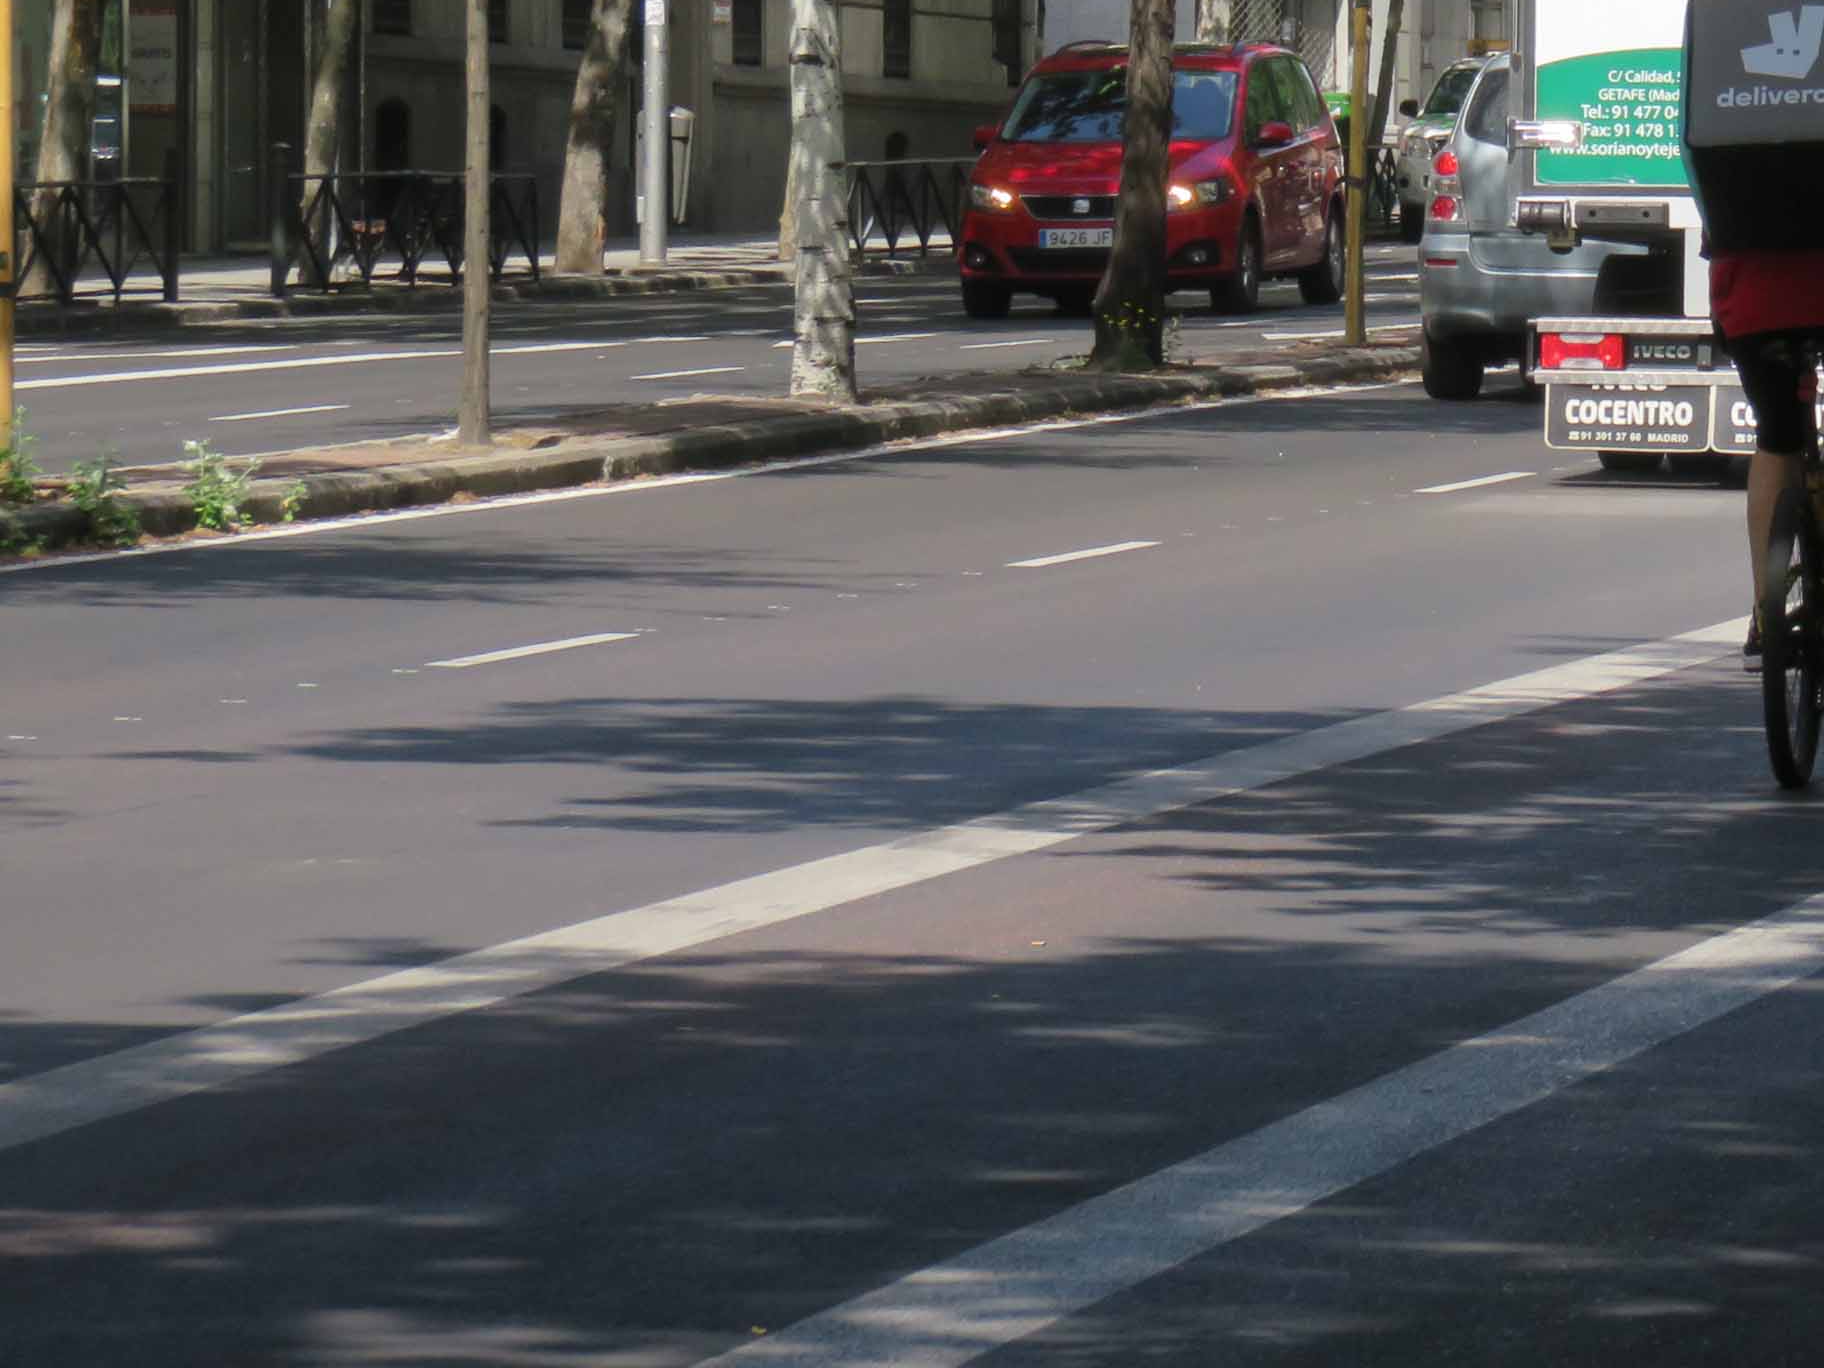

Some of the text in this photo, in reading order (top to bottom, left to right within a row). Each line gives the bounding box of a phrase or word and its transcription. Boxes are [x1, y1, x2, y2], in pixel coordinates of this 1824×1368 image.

[1607, 69, 1623, 83] C/
[1624, 69, 1675, 85] Calidad,
[1598, 88, 1646, 101] GETAFE
[1611, 105, 1629, 119] 91
[1633, 105, 1661, 119] 477
[1613, 123, 1631, 137] 91
[1635, 123, 1664, 137] 478
[1049, 231, 1088, 246] 9426
[1633, 345, 1691, 359] IVECO
[1565, 399, 1693, 426] COCENTRO
[1647, 433, 1689, 444] MADRID
